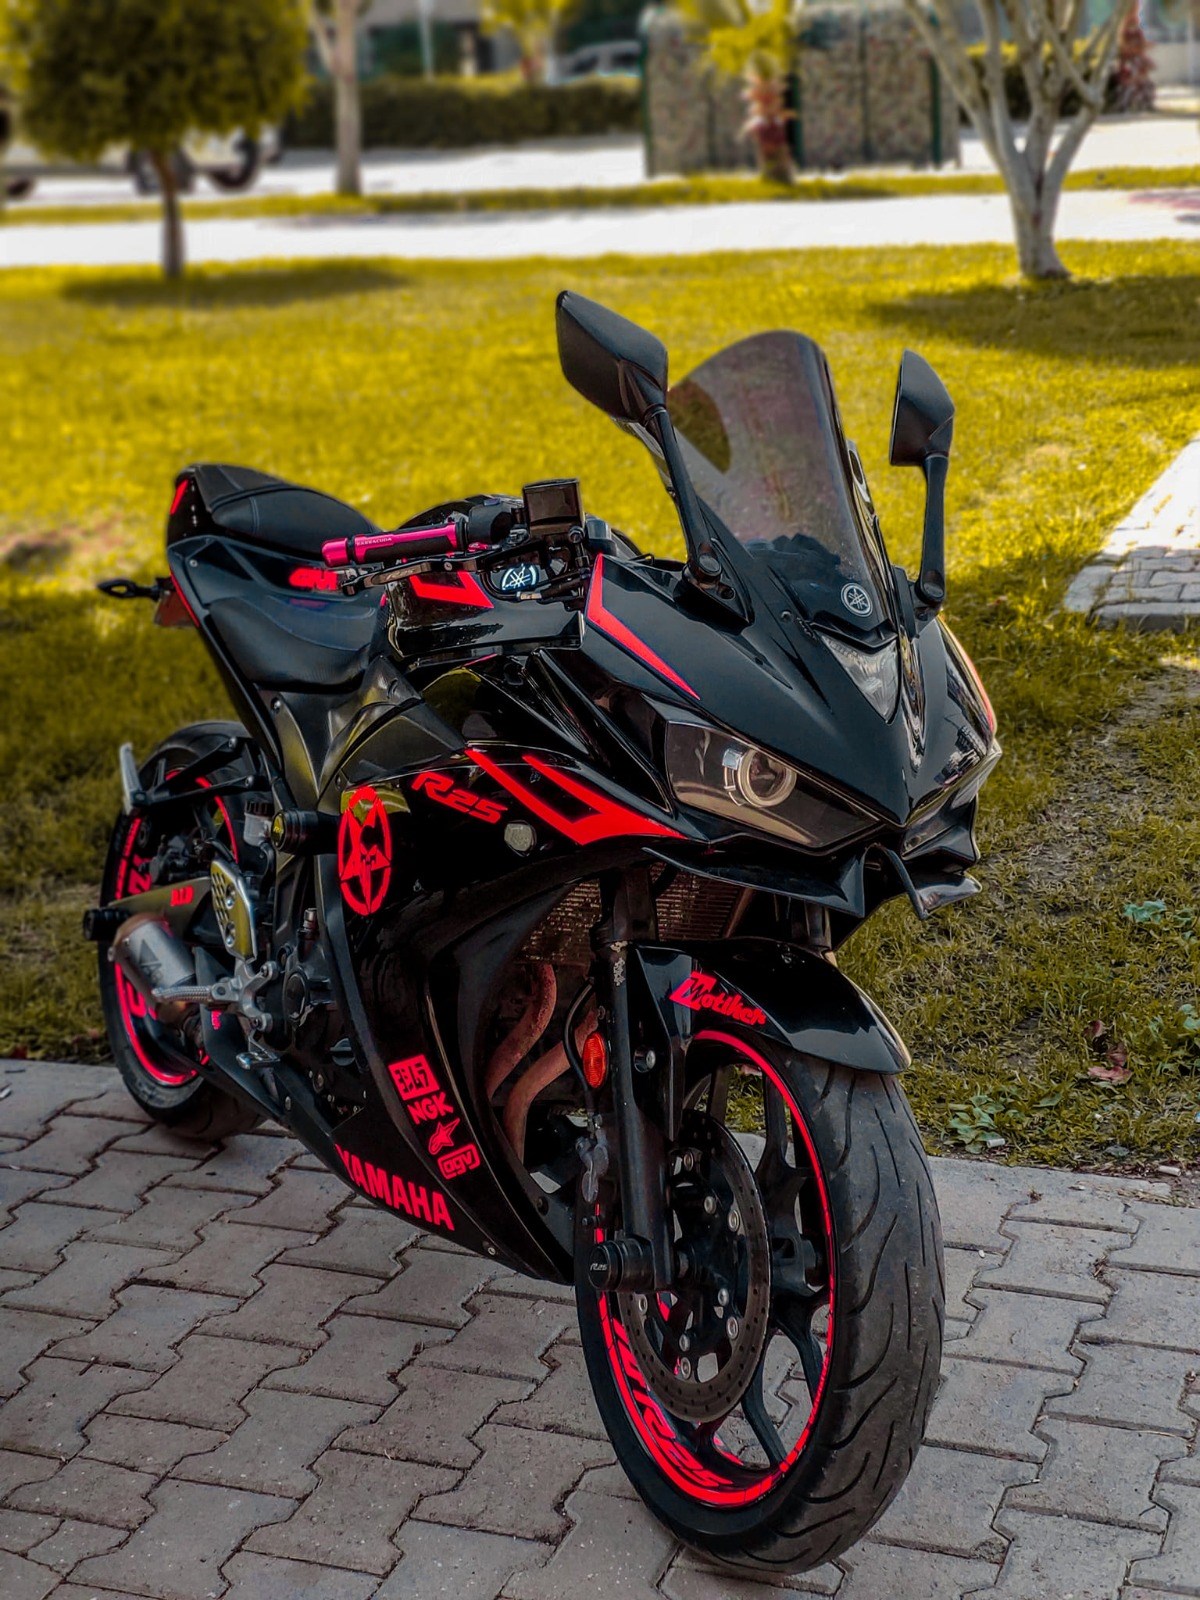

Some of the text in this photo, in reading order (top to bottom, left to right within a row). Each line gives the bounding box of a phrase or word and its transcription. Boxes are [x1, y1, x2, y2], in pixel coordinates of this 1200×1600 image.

[411, 770, 508, 824] R25
[407, 1091, 454, 1125] NGK
[440, 1147, 478, 1178] agv
[335, 1143, 455, 1231] YAMAHA
